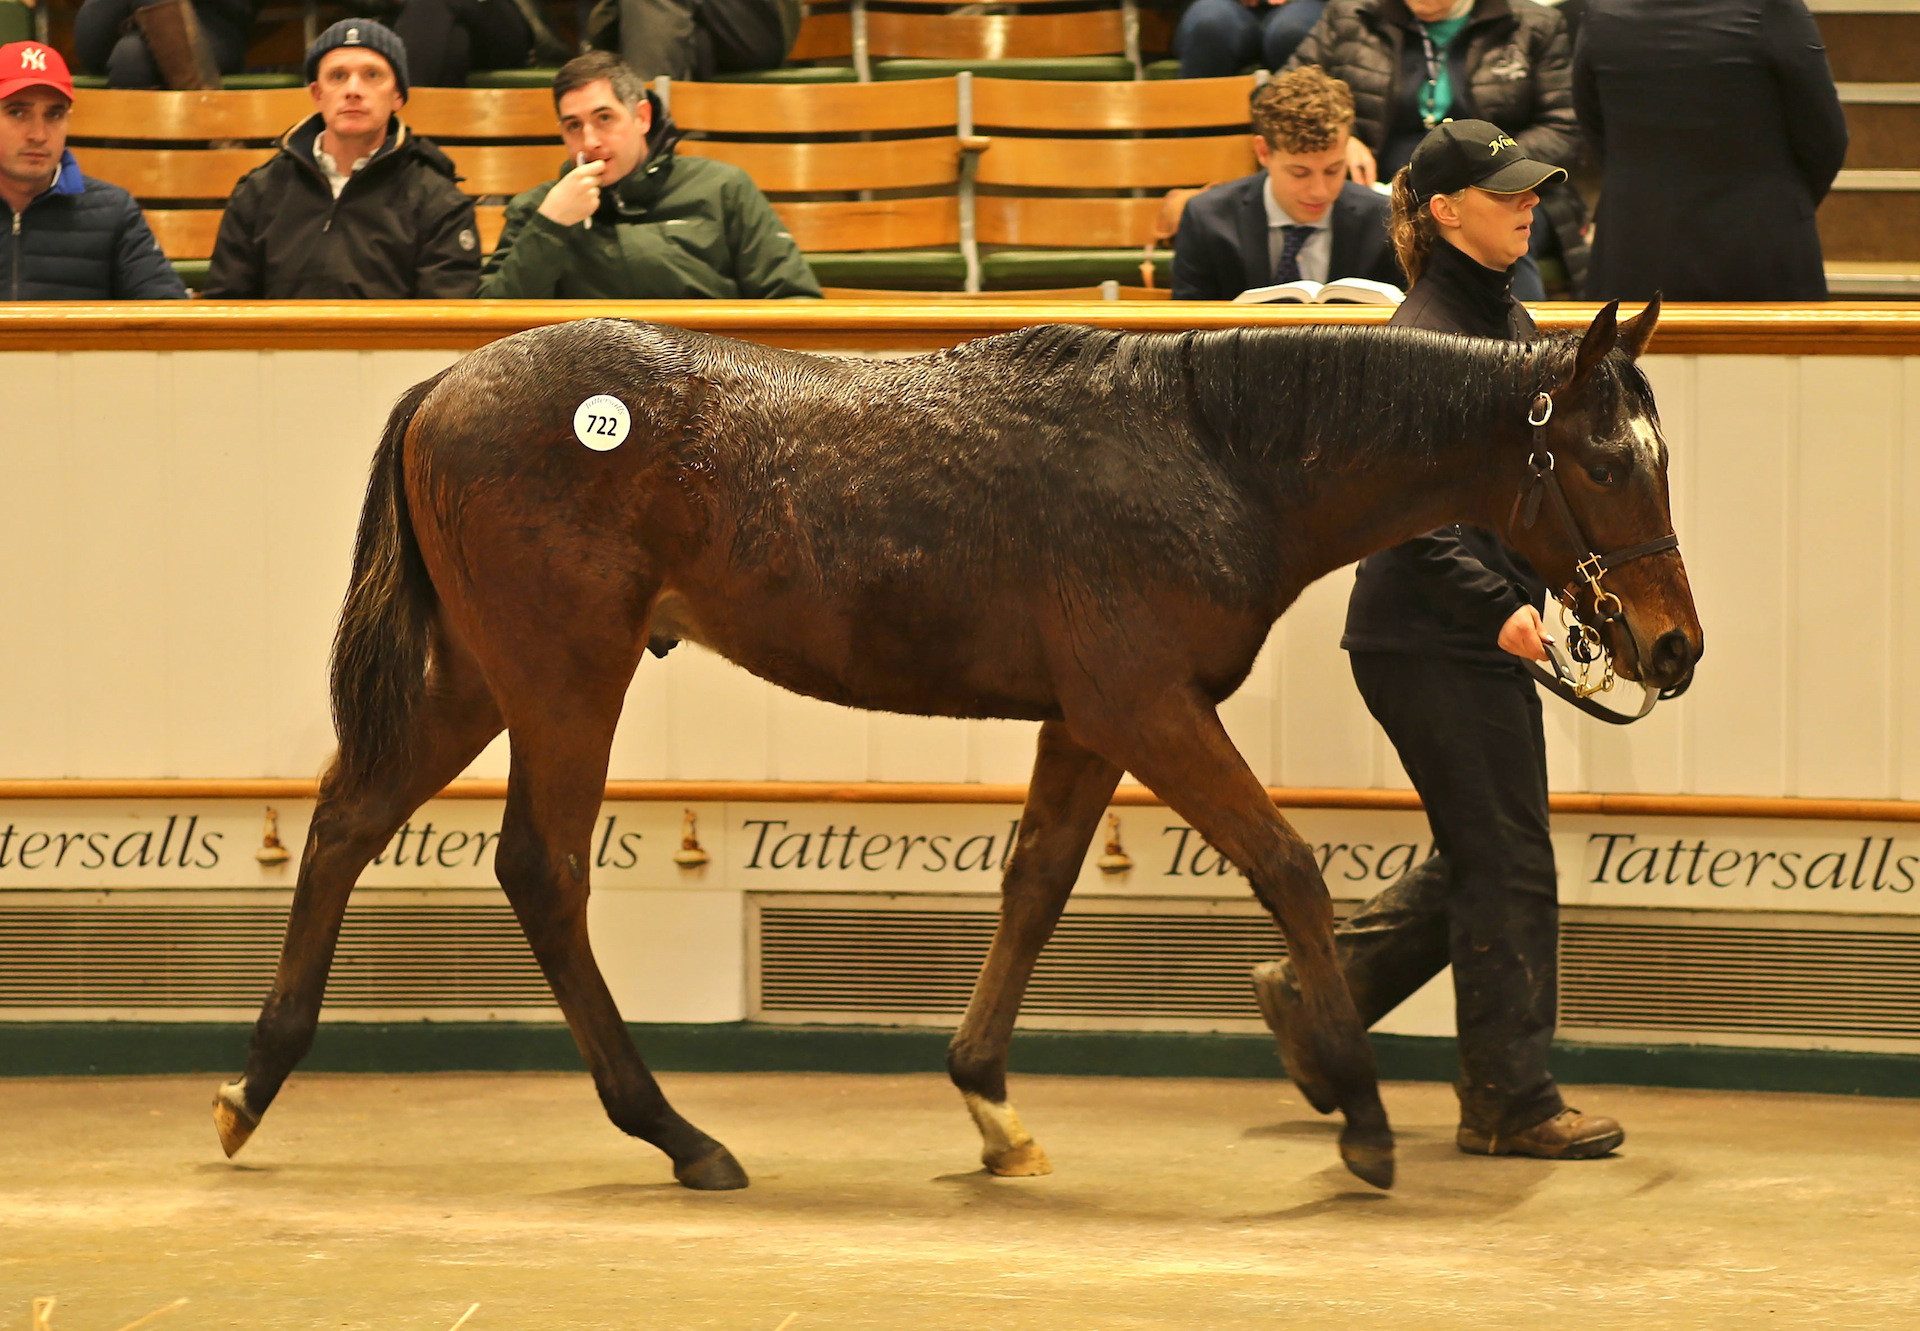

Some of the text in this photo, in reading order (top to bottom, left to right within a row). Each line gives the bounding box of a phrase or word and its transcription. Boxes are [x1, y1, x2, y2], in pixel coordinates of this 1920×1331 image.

[21, 47, 47, 71] NY
[586, 414, 618, 436] 722
[743, 819, 1020, 872] Tattersal
[1588, 832, 1919, 893] Tattersalls
